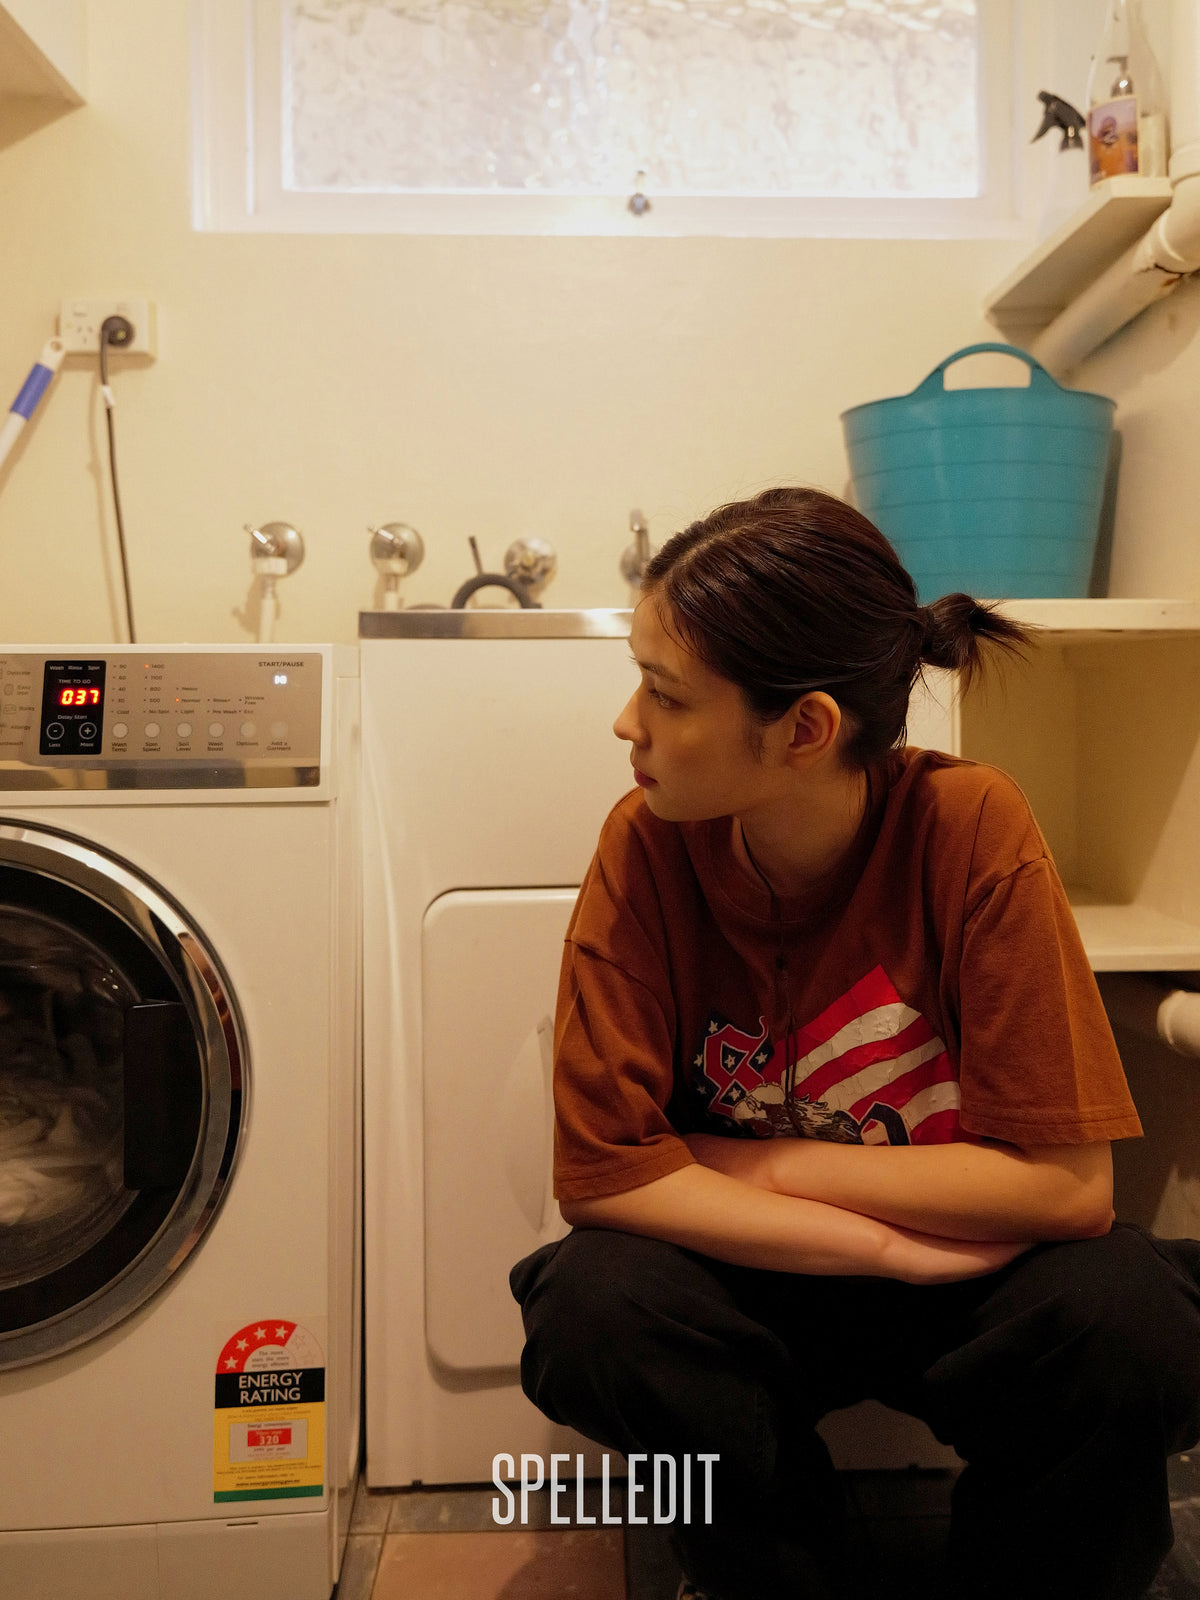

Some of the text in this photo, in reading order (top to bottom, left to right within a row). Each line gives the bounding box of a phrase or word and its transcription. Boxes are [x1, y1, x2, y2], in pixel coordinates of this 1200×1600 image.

[60, 687, 101, 706] 037
[238, 1371, 303, 1390] ENERGY
[240, 1387, 301, 1405] RATING
[259, 1434, 280, 1446] 320
